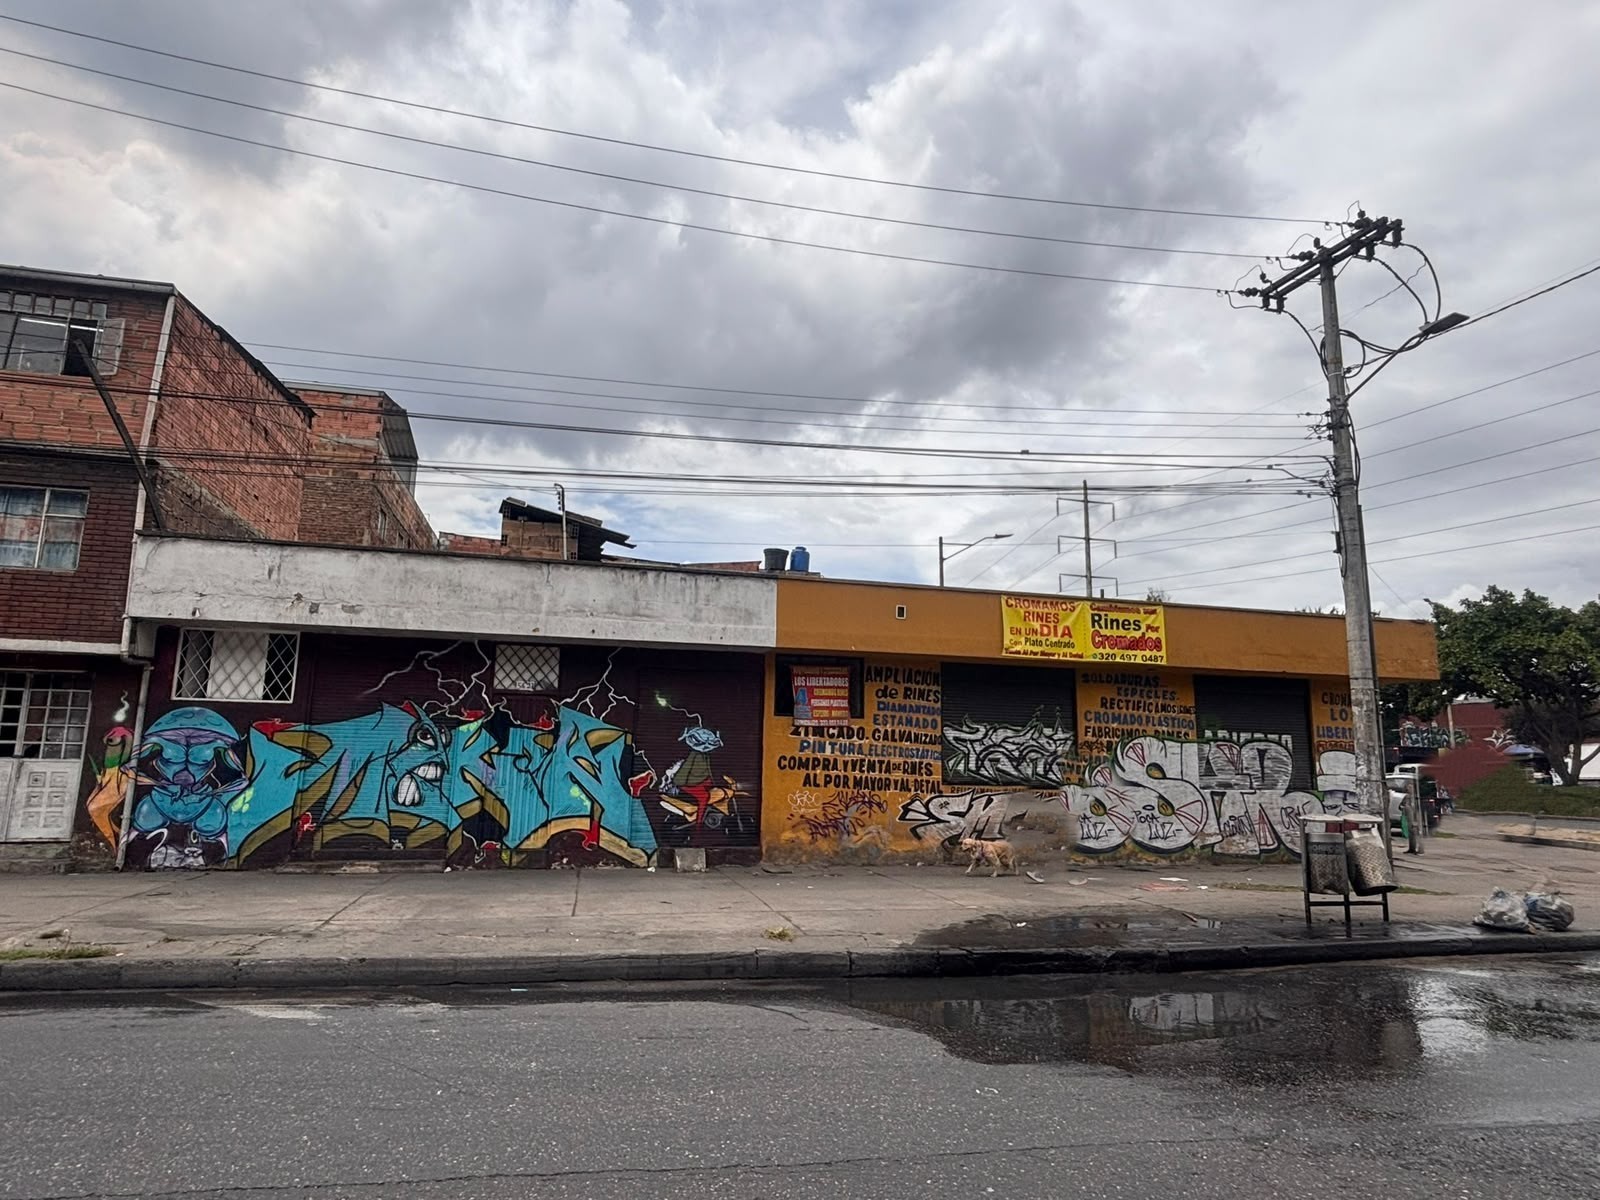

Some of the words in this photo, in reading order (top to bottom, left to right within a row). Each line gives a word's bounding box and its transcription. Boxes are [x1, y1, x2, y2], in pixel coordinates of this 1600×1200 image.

[1005, 597, 1076, 613] CROMAMOS
[1023, 611, 1060, 624] RINES
[1090, 613, 1142, 631] Rines
[1009, 626, 1022, 636] EN
[1025, 627, 1038, 636] UN
[1040, 624, 1073, 639] DIA
[1009, 638, 1023, 646] Con
[1025, 637, 1043, 648] Plato
[1044, 638, 1076, 649] Centrado
[1091, 629, 1162, 652] Cromados
[1098, 652, 1116, 661] 320
[1119, 653, 1138, 662] 497
[1141, 654, 1164, 663] 0487
[794, 676, 806, 687] LOS
[875, 685, 899, 699] de
[902, 686, 941, 704] RINES
[1100, 696, 1177, 714] RECTIFICAMOS
[1084, 710, 1144, 726] CROMADO
[871, 728, 942, 745] GALVANIZADO
[850, 758, 891, 774] VENTA
[802, 773, 821, 788] AL
[823, 774, 850, 789] POR
[852, 775, 891, 791] MAYOR
[899, 777, 912, 792] AL
[913, 778, 944, 794] DETAL
